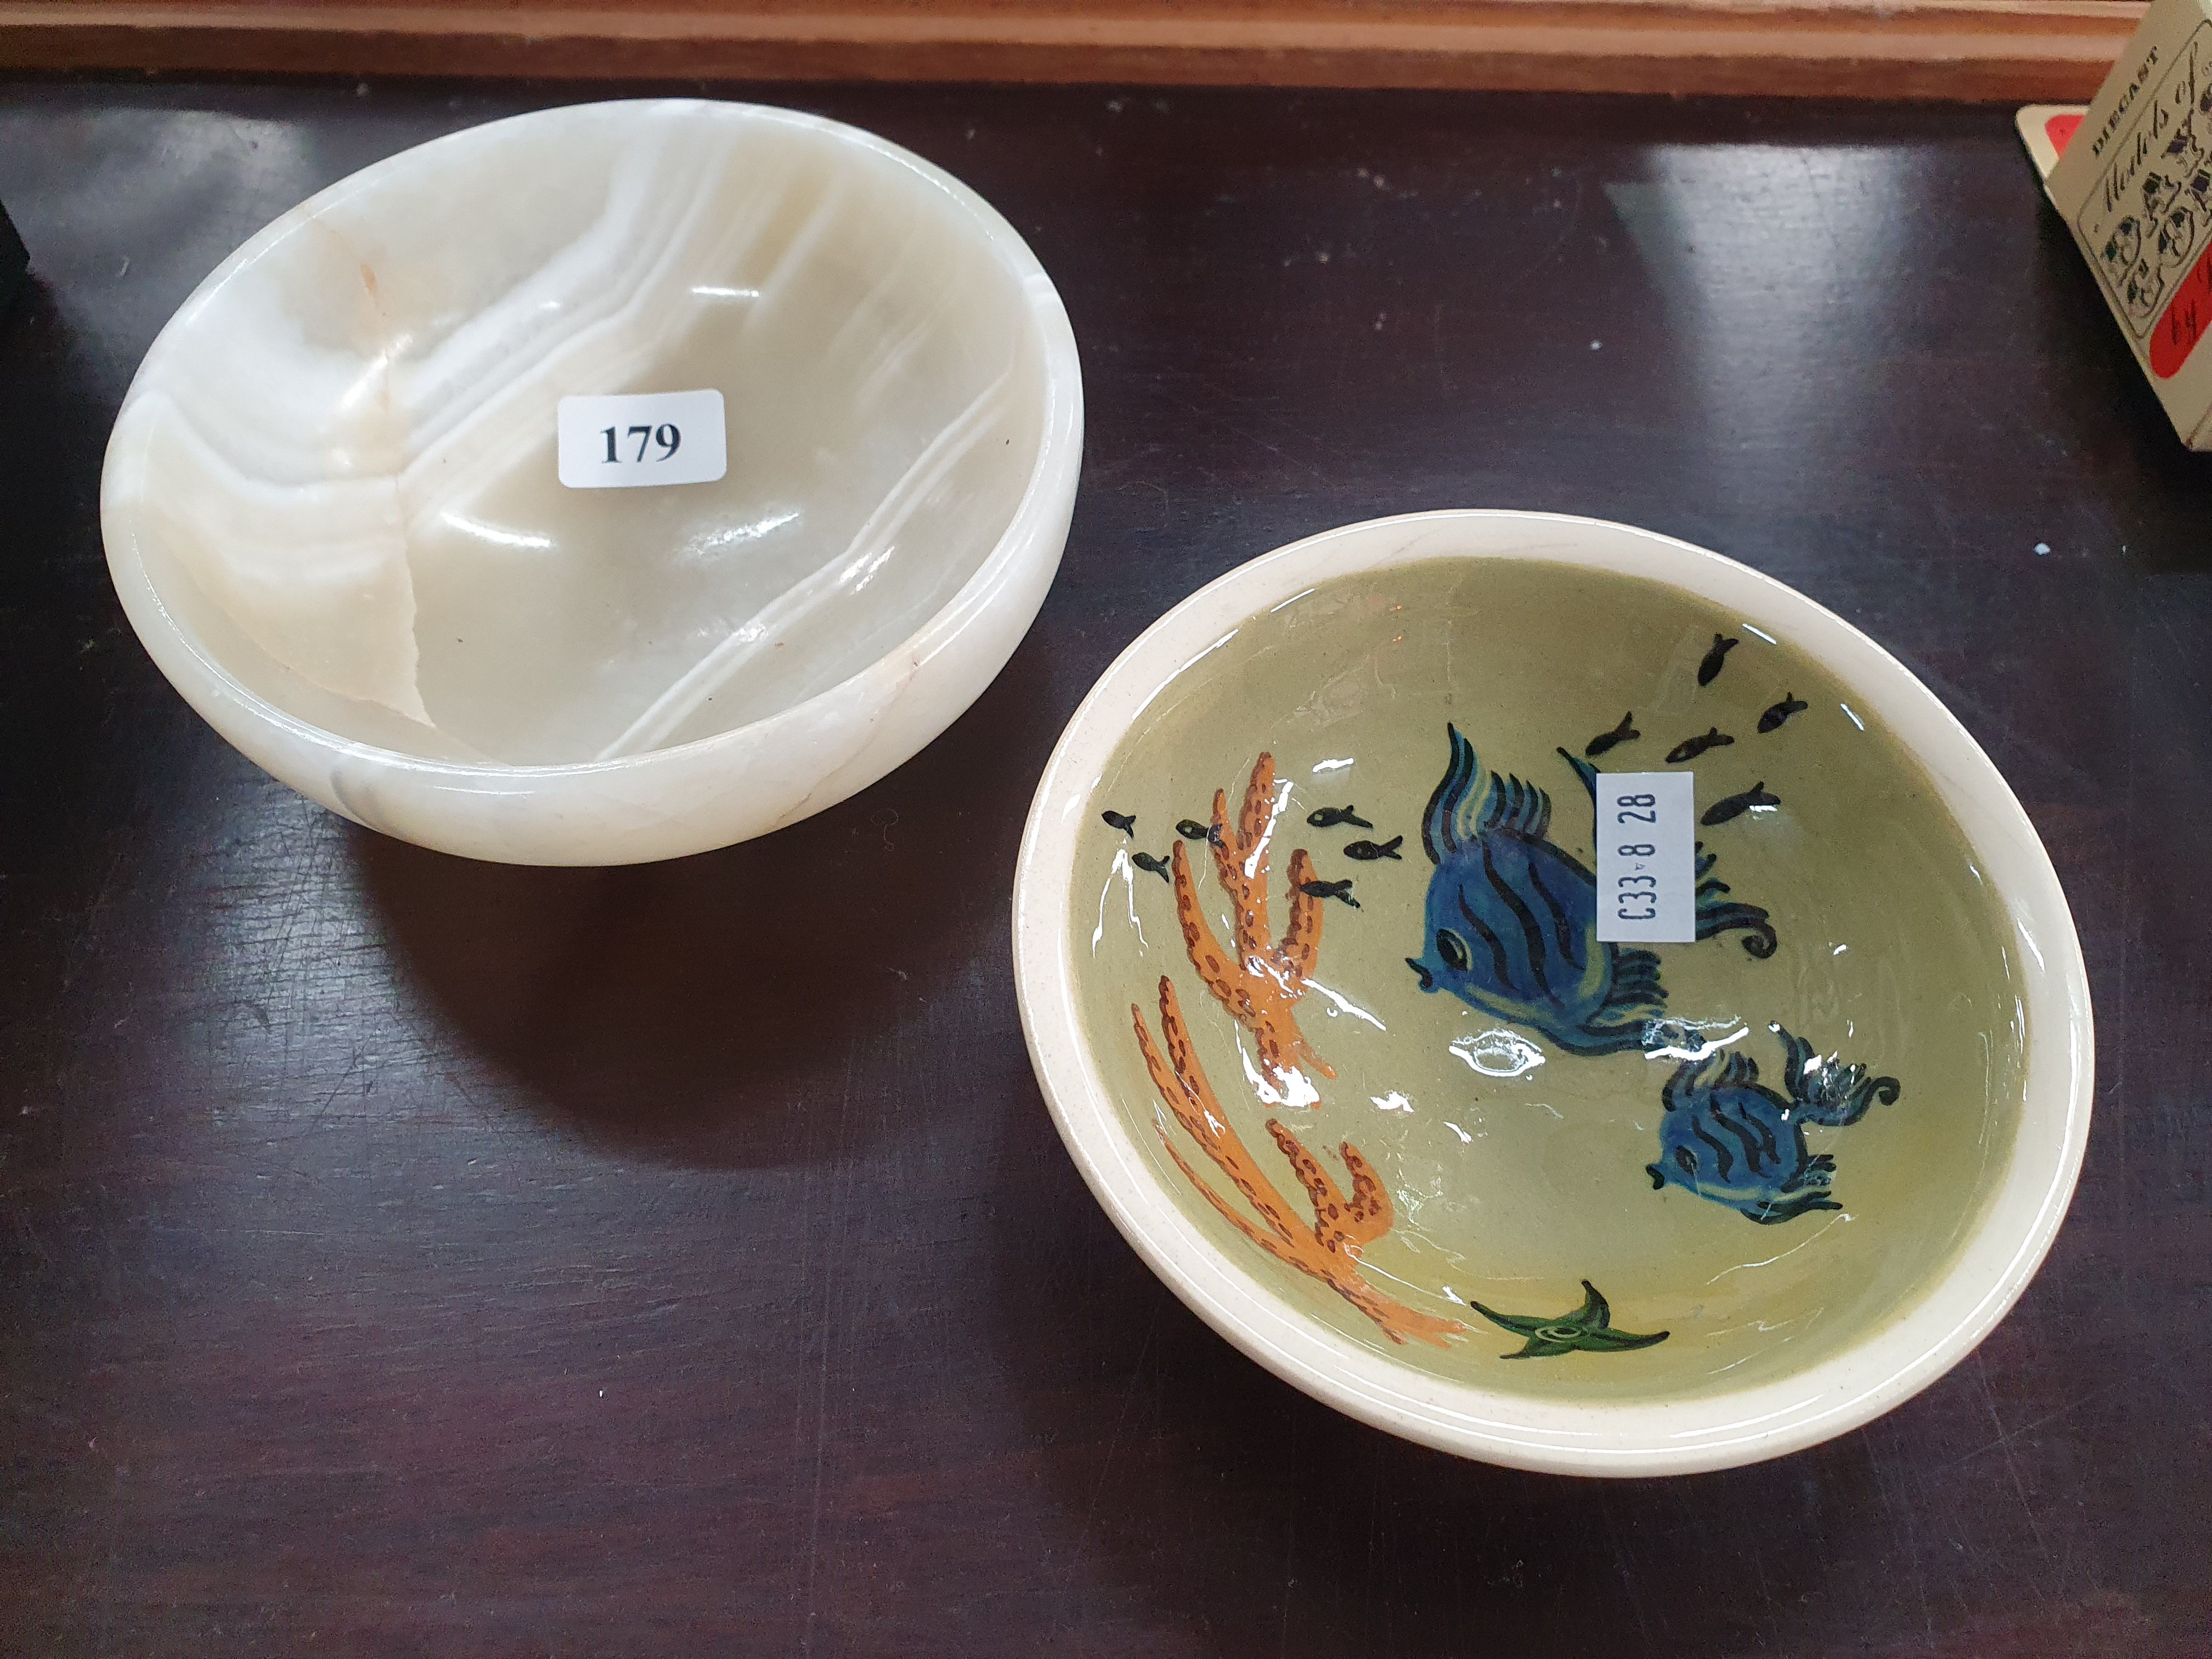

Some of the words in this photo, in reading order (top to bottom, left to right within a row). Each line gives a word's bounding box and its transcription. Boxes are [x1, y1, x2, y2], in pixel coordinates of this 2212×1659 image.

[2092, 46, 2158, 158] DIECAST
[600, 423, 681, 463] 179
[1617, 793, 1657, 823] 28
[1617, 876, 1657, 919] C33
